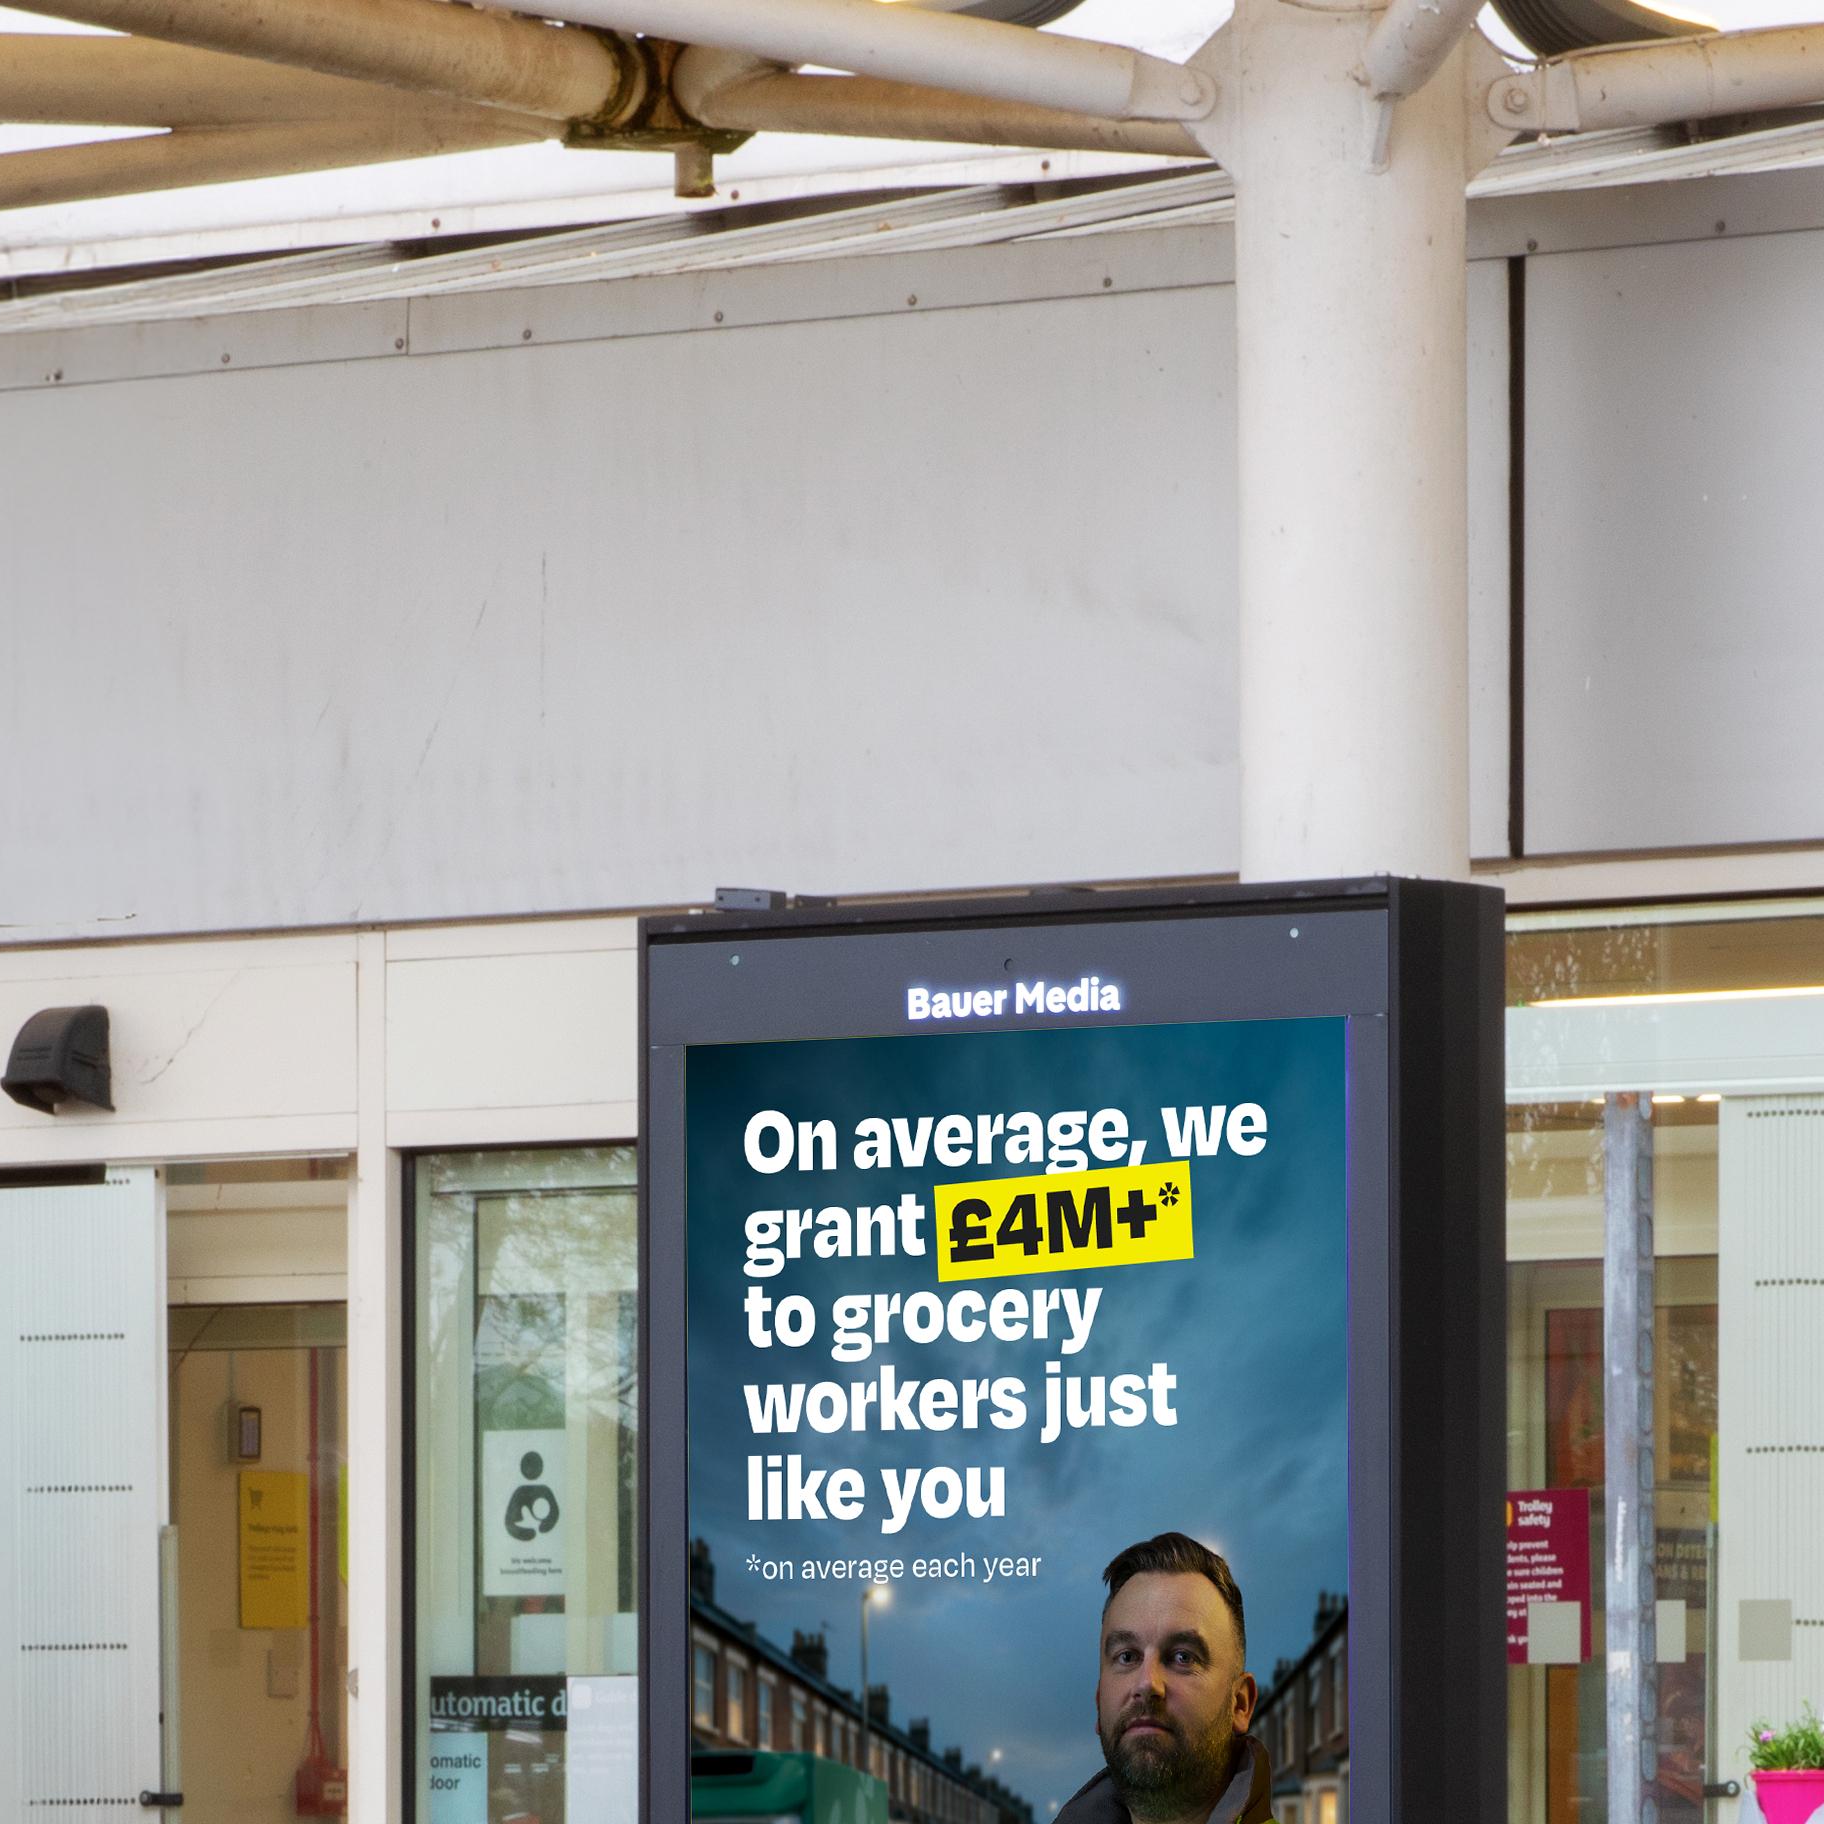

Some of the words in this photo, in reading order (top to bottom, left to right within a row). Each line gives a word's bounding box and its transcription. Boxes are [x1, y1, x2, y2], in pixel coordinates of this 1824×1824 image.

[907, 987, 1008, 1020] Bauer
[1015, 976, 1121, 1015] Media
[744, 1109, 837, 1174] On
[853, 1108, 1147, 1175] average,
[1161, 1102, 1268, 1157] we
[743, 1193, 926, 1277] grant
[744, 1286, 816, 1348] to
[831, 1285, 1103, 1362] grocery
[743, 1365, 1028, 1434] workers
[1041, 1361, 1178, 1444] just
[747, 1454, 866, 1521] like
[881, 1466, 1006, 1535] you
[1518, 1500, 1553, 1514] Trolley
[1518, 1514, 1551, 1528] safety
[801, 1558, 904, 1585] average
[912, 1552, 975, 1578] each
[983, 1556, 1042, 1583] year
[431, 1689, 545, 1717] utomatic
